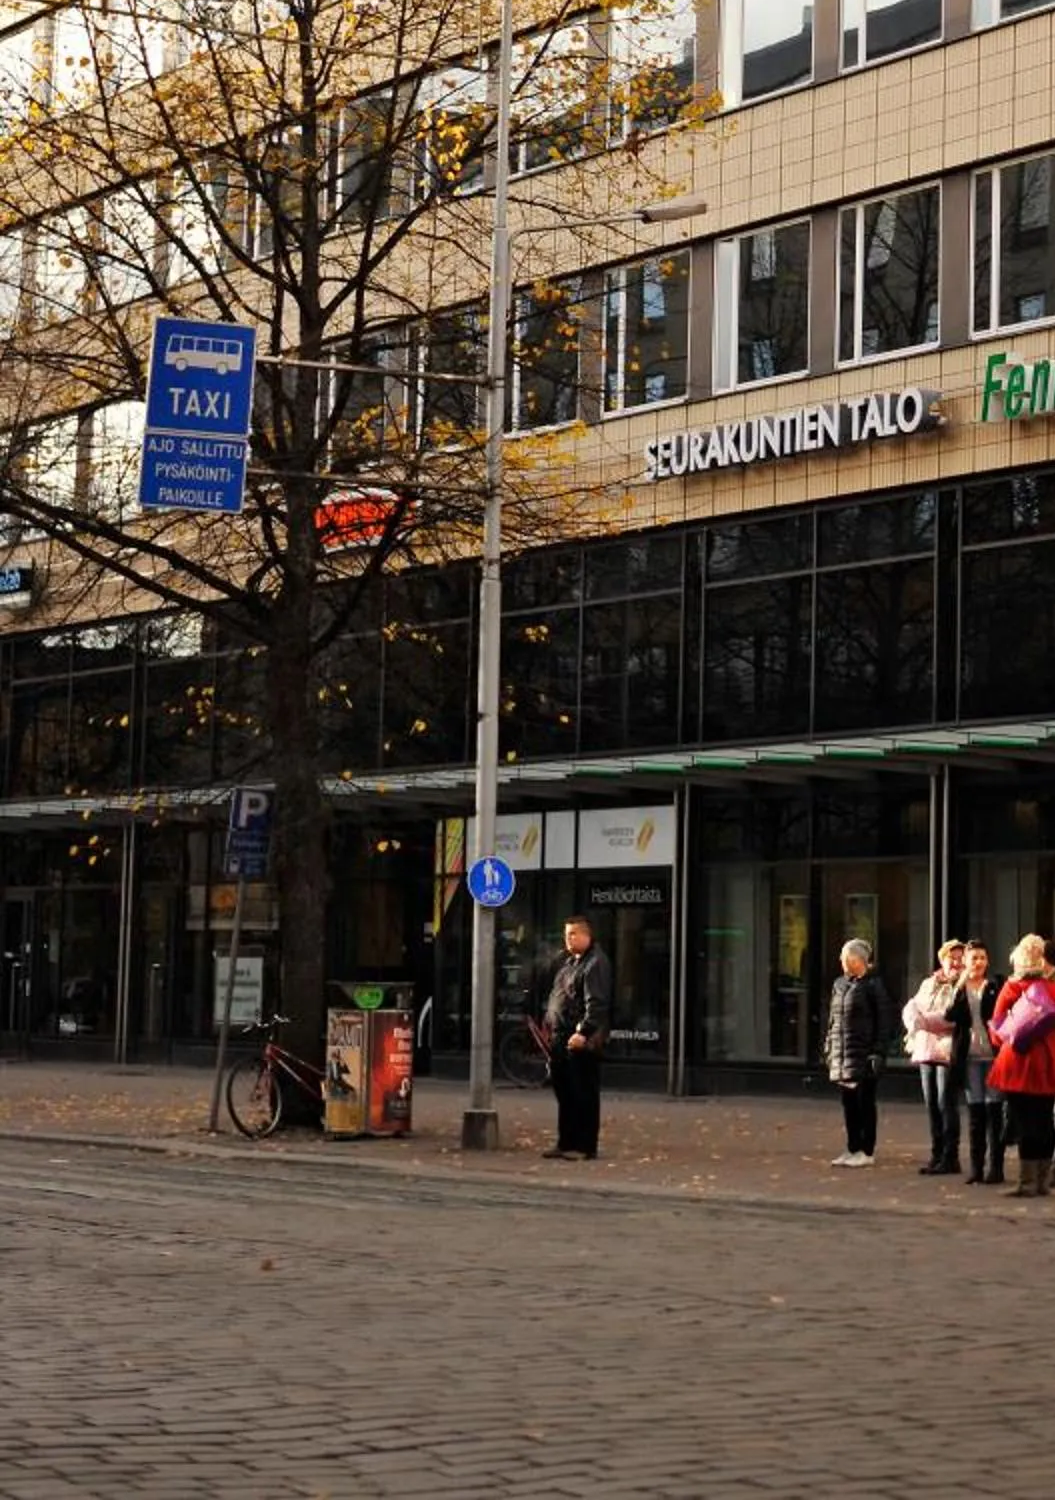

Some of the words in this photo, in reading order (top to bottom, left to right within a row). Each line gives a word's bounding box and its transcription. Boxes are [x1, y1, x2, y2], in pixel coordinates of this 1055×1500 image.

[169, 386, 231, 419] TAXI
[148, 438, 175, 453] AJO
[181, 441, 243, 459] SALLITTU
[645, 401, 840, 483] SEURAKUNTIEN
[847, 386, 923, 442] TALO
[158, 487, 225, 507] PAIKOILLE
[238, 791, 270, 828] P
